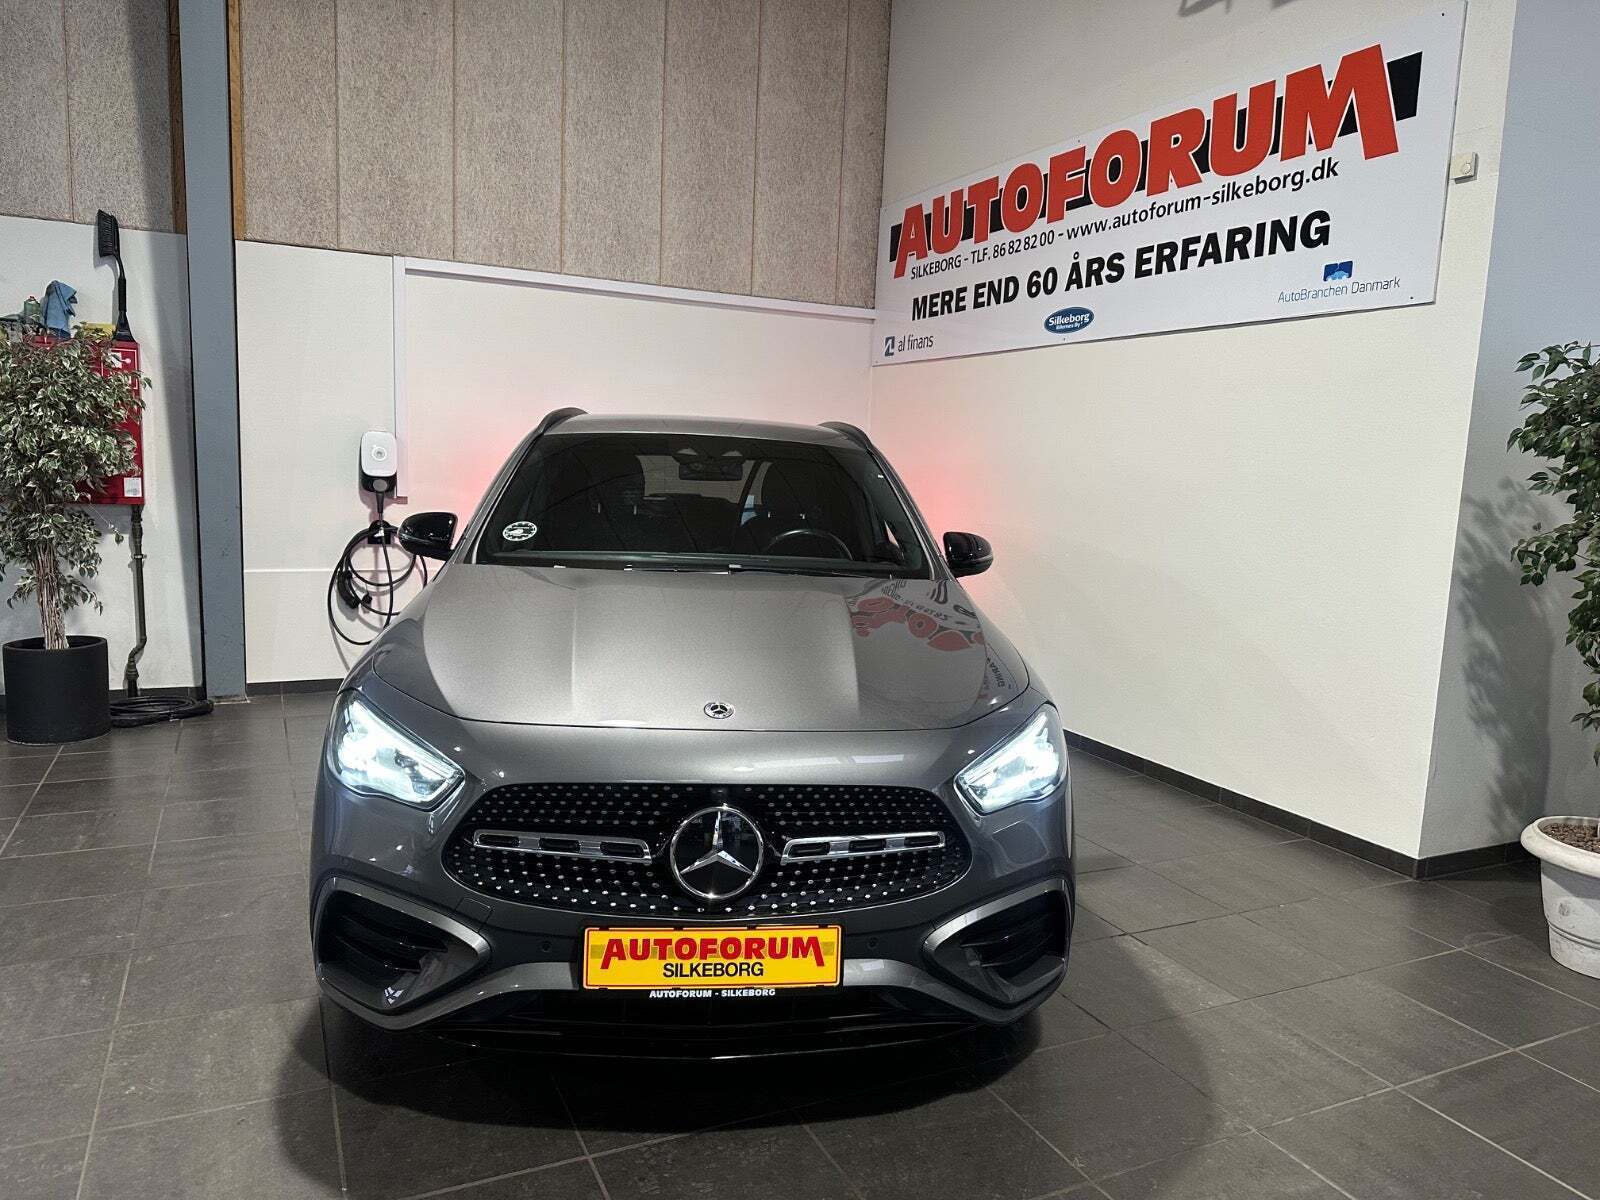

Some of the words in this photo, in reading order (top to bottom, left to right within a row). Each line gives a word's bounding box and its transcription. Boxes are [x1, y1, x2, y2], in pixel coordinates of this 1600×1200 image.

[893, 43, 1400, 278] AUTOFORUM
[910, 254, 962, 280] SILKEBORG
[971, 247, 991, 265] TLF.
[1066, 156, 1340, 240] www.autoforum-silkeborg.dk
[911, 286, 968, 321] MERE
[973, 276, 1020, 309] END
[1026, 266, 1058, 299] 60
[1064, 251, 1125, 292] ÅRS
[1134, 210, 1331, 279] ERFARING
[1277, 284, 1348, 303] AutoBranchen
[1351, 276, 1400, 294] Danmark
[1048, 313, 1090, 326] Silkeborg
[897, 334, 906, 352] al
[908, 334, 934, 351] finans
[600, 936, 825, 970] AUTOFORUM
[662, 962, 764, 978] SILKEBORG
[649, 990, 712, 998] AUTOFORUM
[721, 989, 776, 997] SILKEBORG
